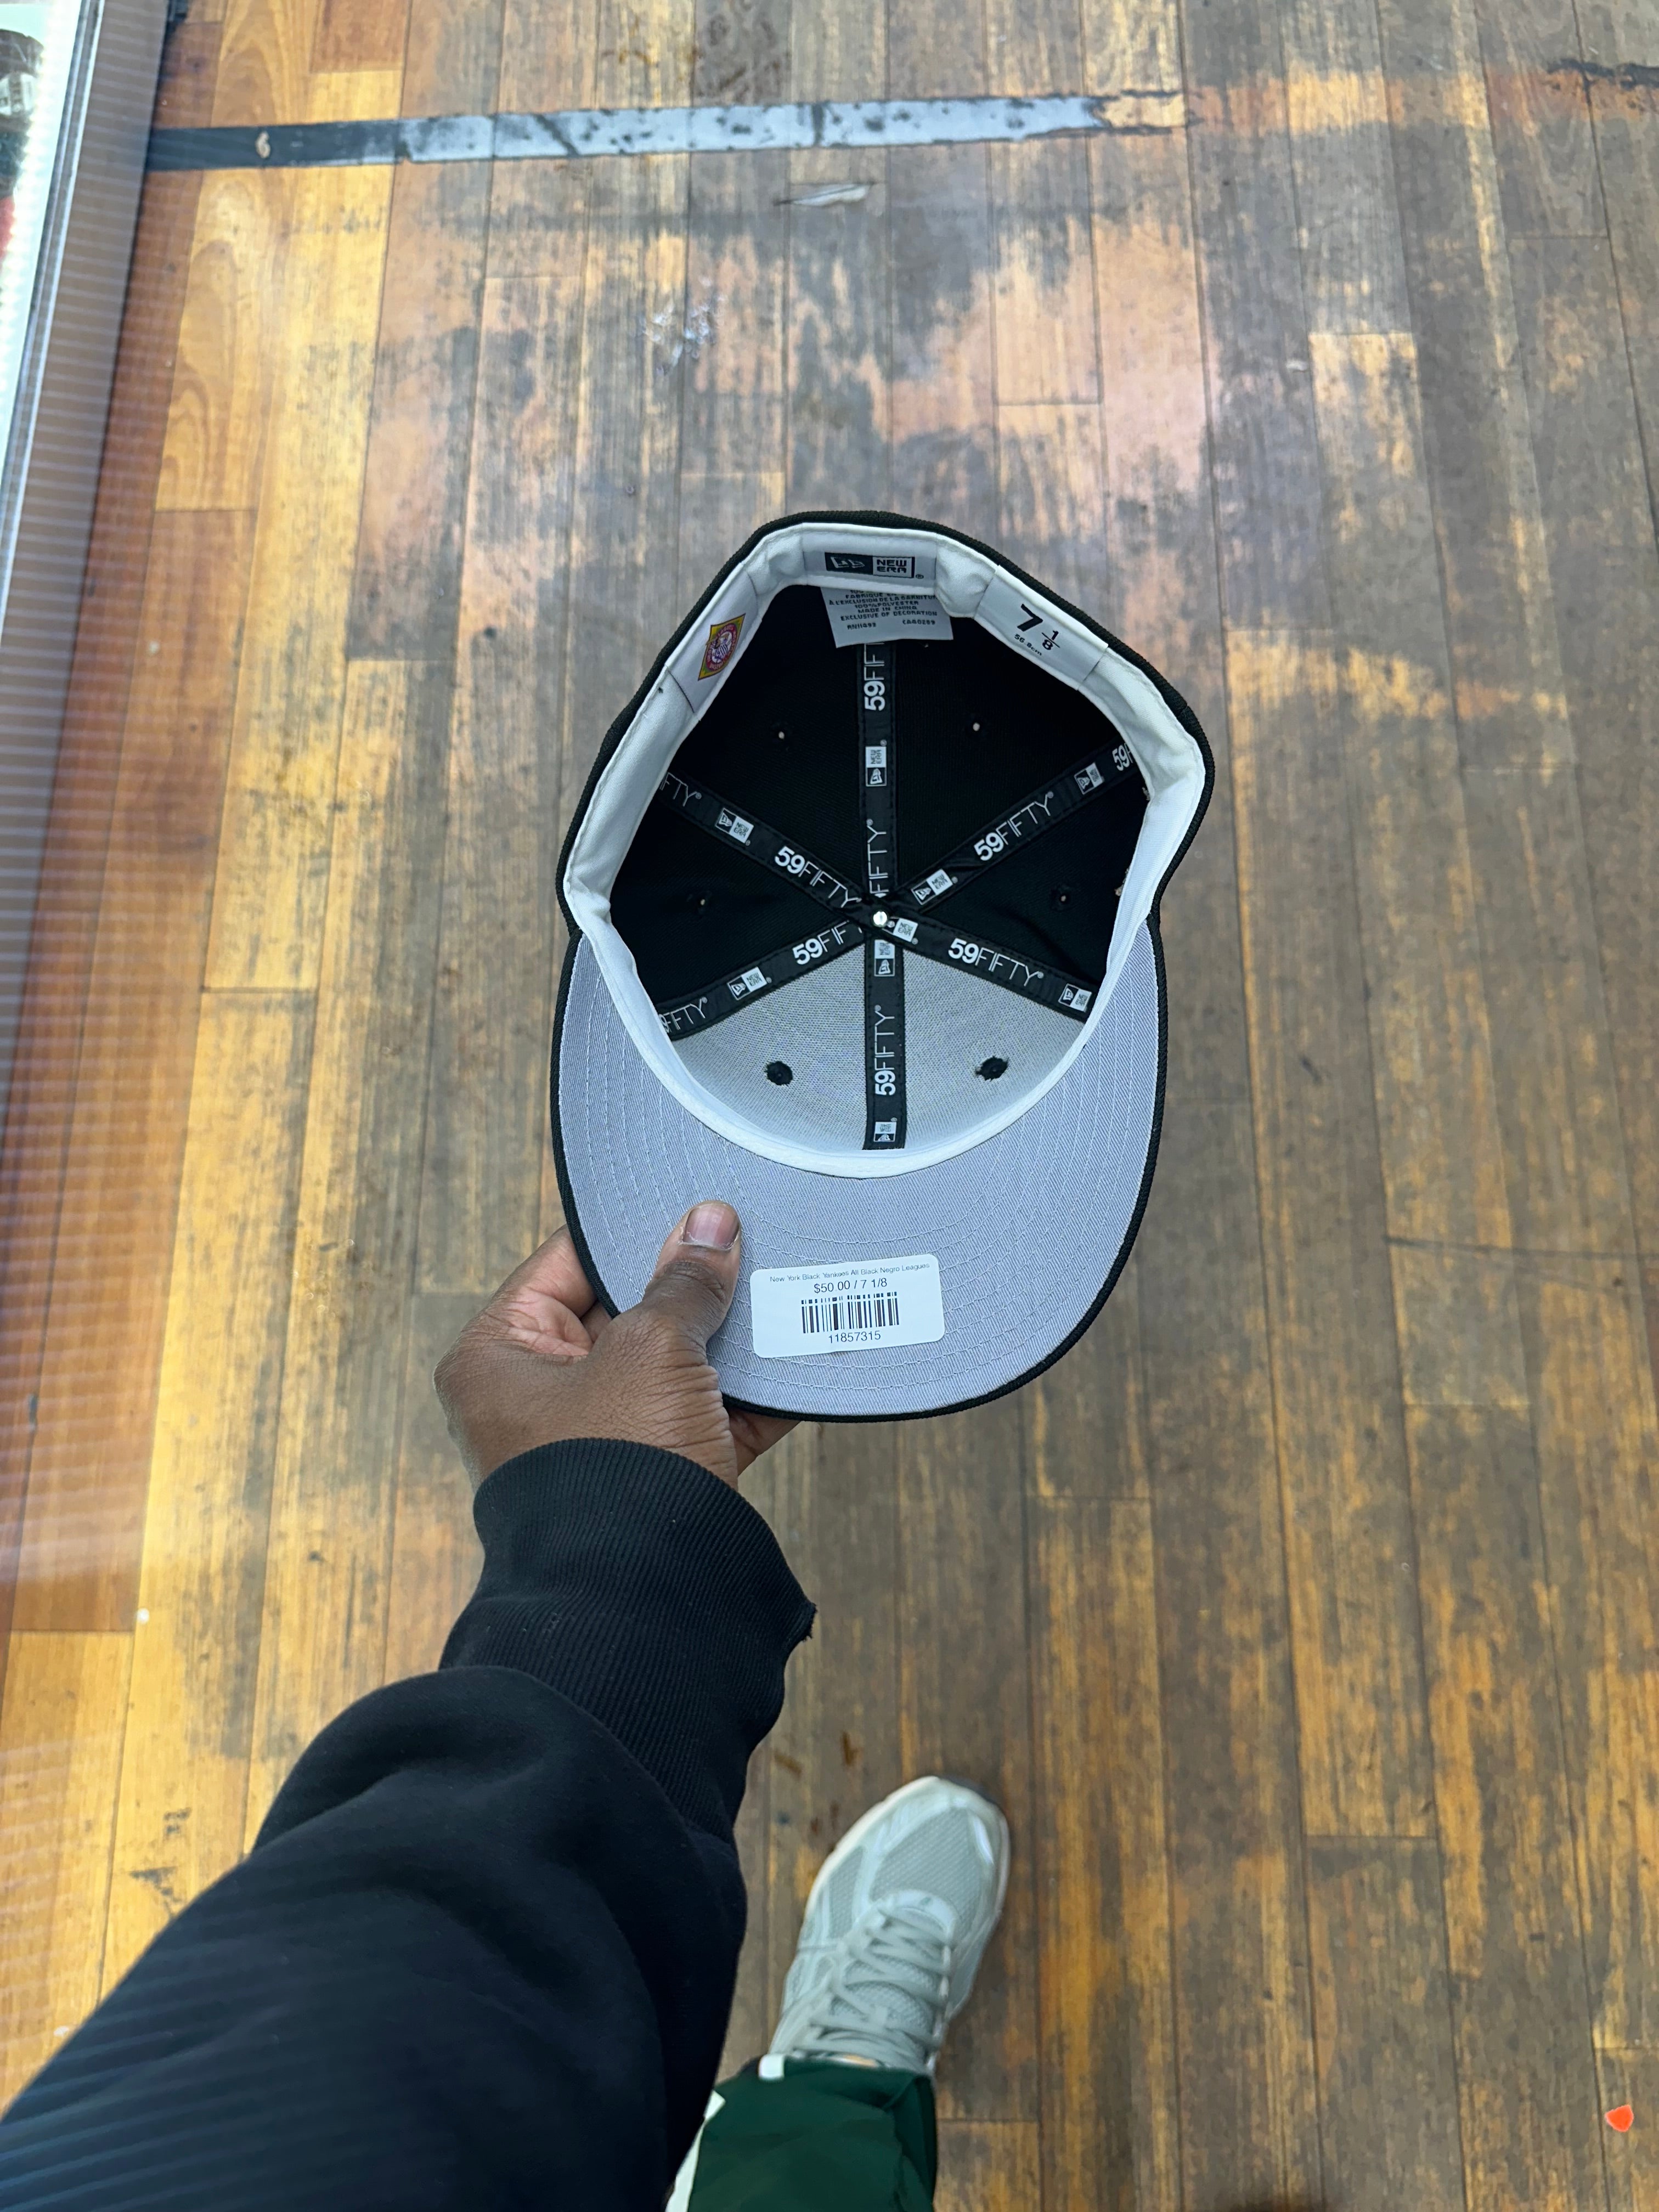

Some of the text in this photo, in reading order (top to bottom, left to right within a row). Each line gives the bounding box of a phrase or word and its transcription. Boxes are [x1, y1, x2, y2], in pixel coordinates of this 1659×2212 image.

[840, 613, 879, 621] EXCLUSIVE
[1017, 603, 1043, 632] 7
[974, 794, 1051, 861] 59FIFTY
[775, 846, 860, 908] 59FIFTY
[948, 938, 1039, 986] 59FIFTY
[874, 1011, 896, 1096] 59FIFTY
[901, 1263, 930, 1271] Leagues
[860, 1279, 867, 1289] 7
[871, 1277, 887, 1288] 1/8
[828, 1330, 881, 1344] 11857315
